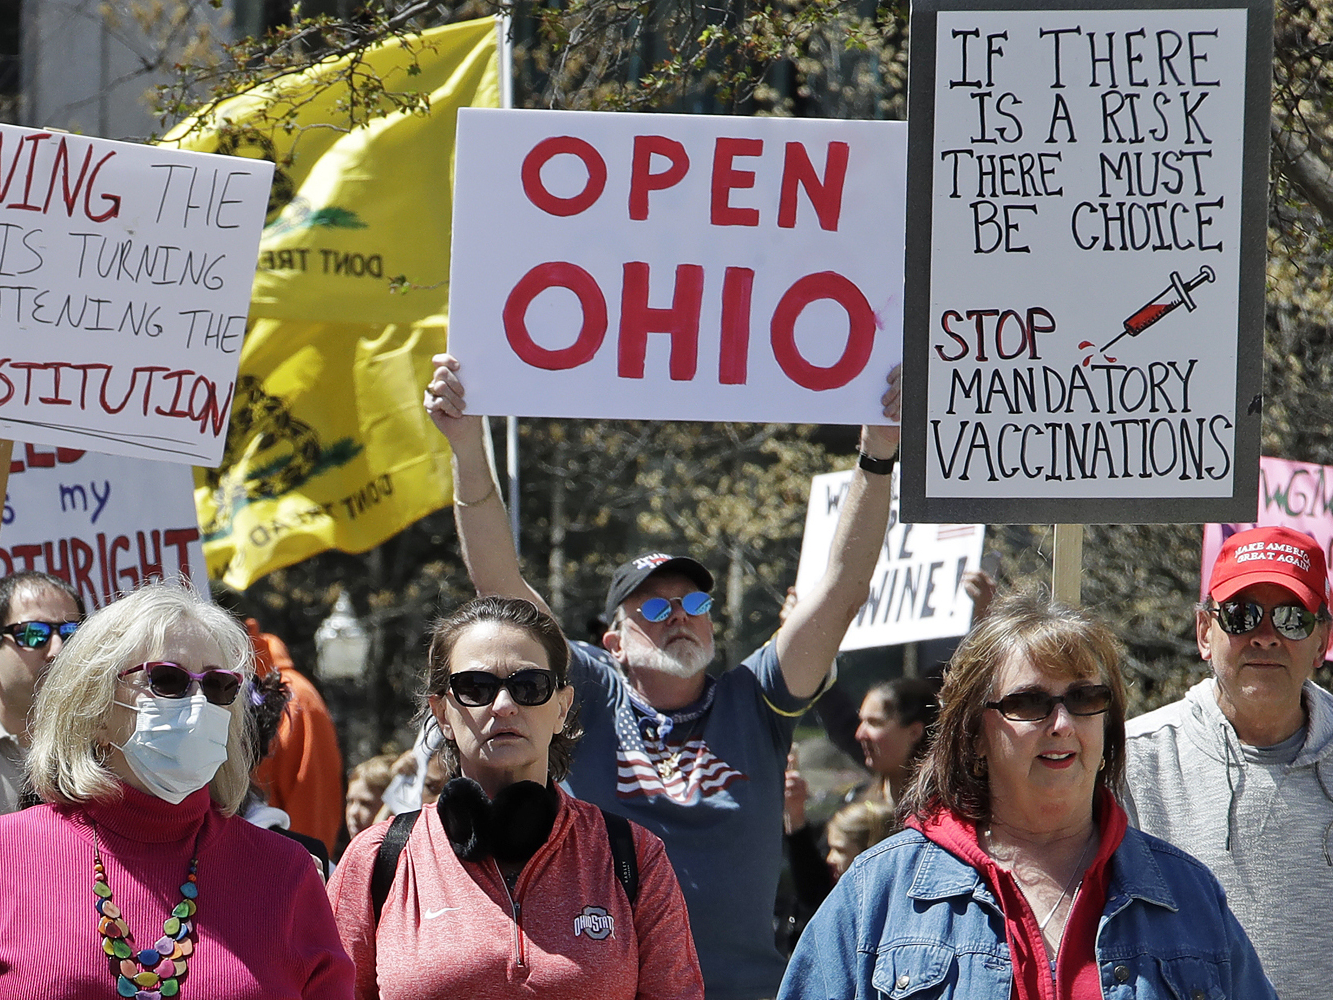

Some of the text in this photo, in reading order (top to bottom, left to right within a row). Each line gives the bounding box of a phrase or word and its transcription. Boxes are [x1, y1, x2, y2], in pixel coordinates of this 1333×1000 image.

[949, 26, 1220, 89] IF THERE
[970, 90, 1213, 144] IS A RISK
[151, 163, 251, 228] THE
[521, 135, 850, 232] OPEN
[941, 149, 1213, 198] THERE MUST
[969, 196, 1224, 253] BE CHOICE
[69, 232, 226, 291] TURNING
[179, 309, 246, 353] THE
[503, 261, 876, 391] OHIO
[934, 307, 1056, 361] STOP
[946, 359, 1198, 415] MANDATORY
[931, 415, 1233, 481] VACCINATIONS
[59, 480, 111, 524] my
[1234, 541, 1311, 566] MAKE AMERICA
[1236, 551, 1310, 572] GREAT AGAIN
